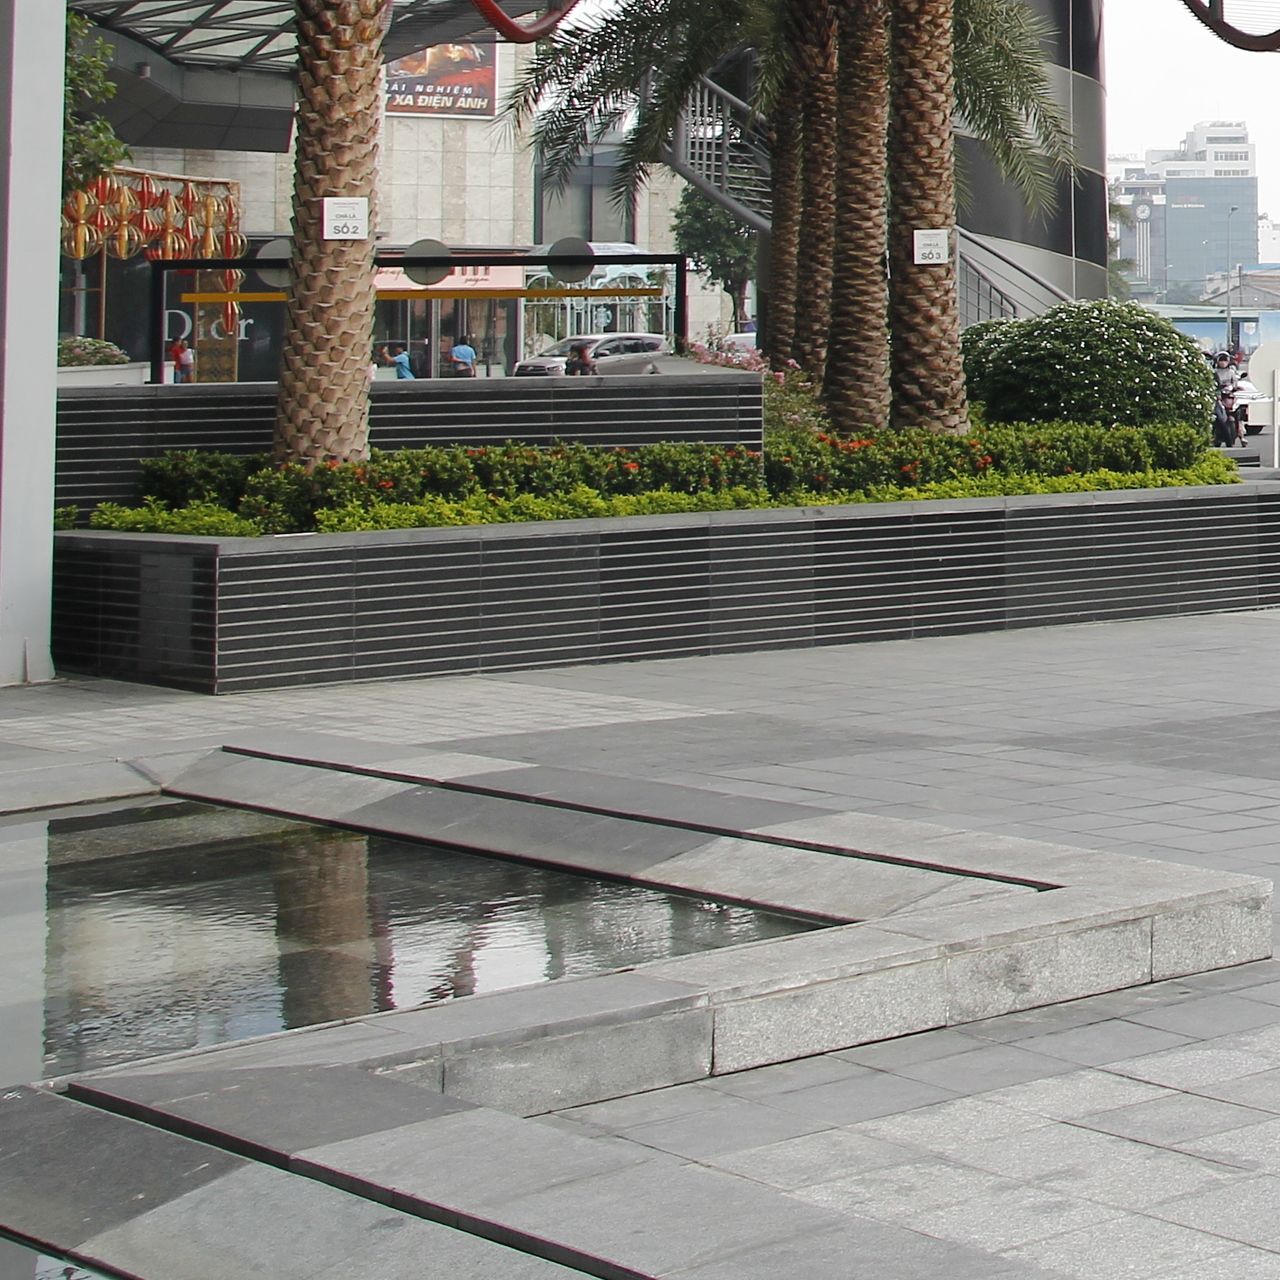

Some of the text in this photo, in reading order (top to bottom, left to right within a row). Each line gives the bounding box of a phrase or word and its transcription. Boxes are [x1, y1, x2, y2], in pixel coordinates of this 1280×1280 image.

[415, 84, 473, 95] NGHIỆM
[393, 94, 414, 106] XA
[417, 93, 453, 109] ĐIỆN
[455, 94, 488, 109] ẢNH
[350, 225, 359, 234] 2
[936, 252, 941, 260] 3
